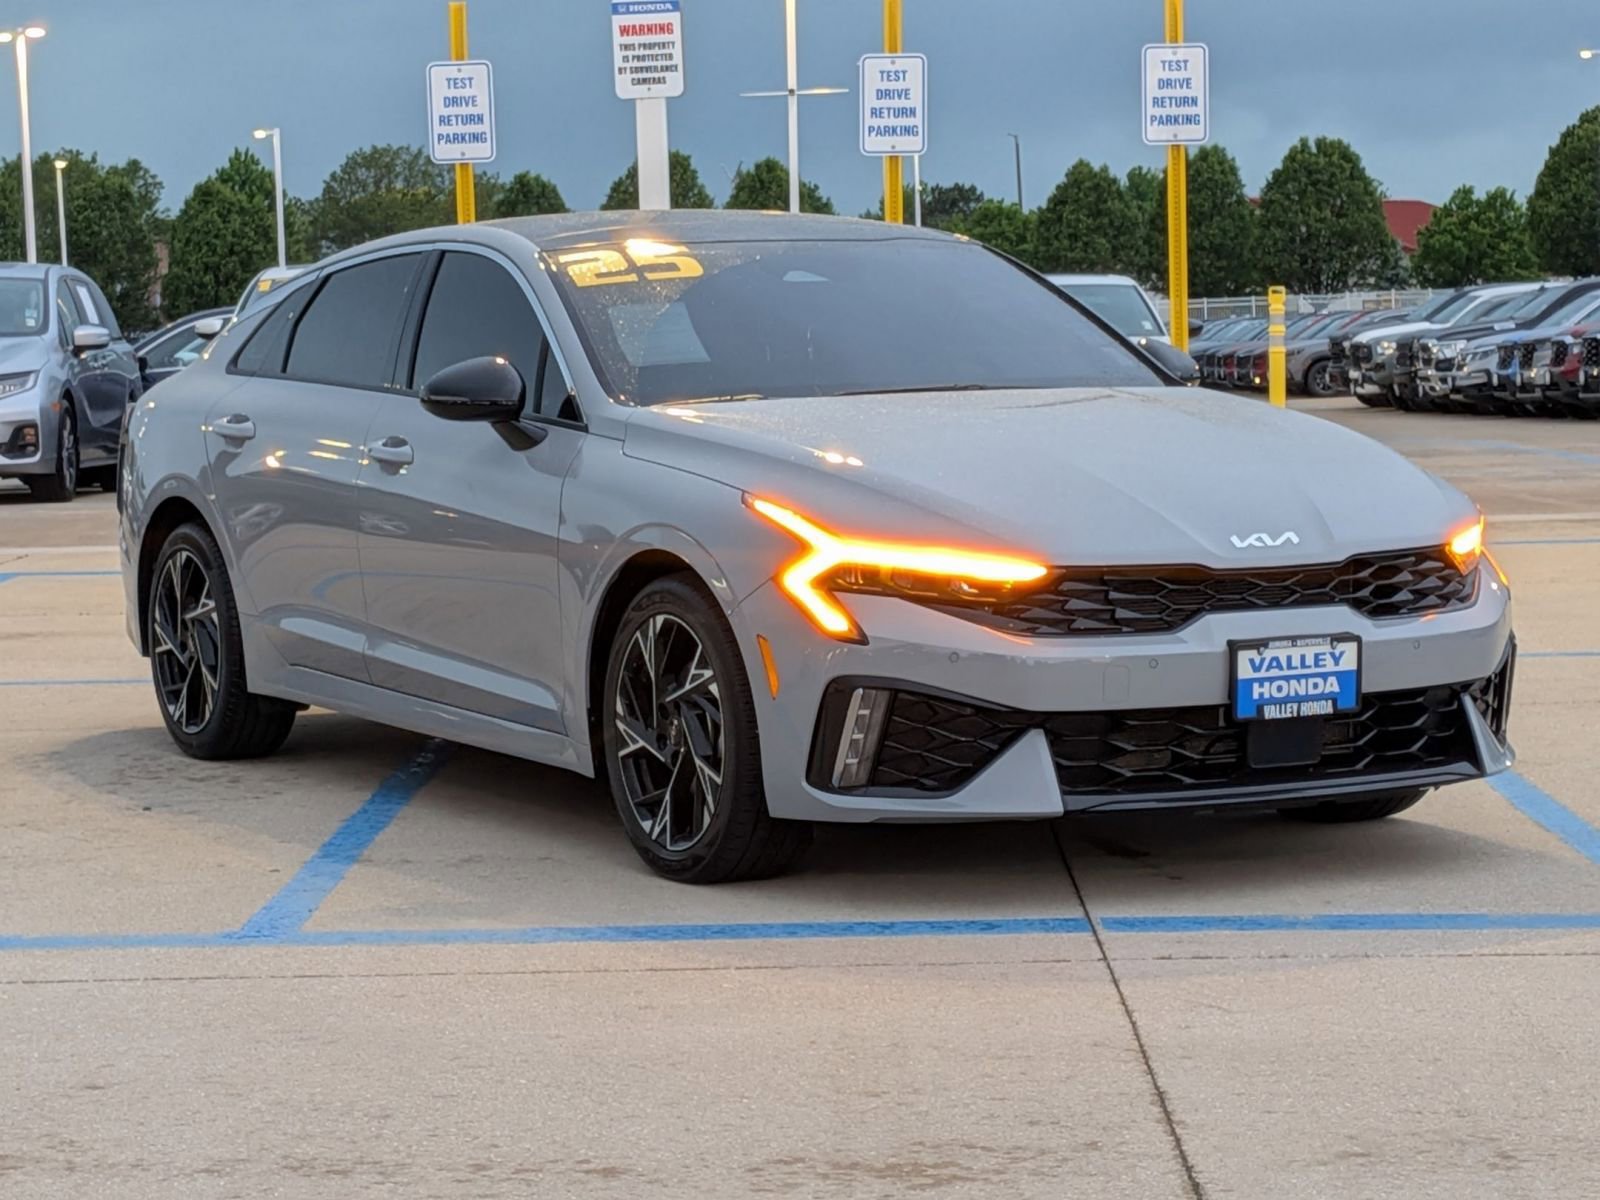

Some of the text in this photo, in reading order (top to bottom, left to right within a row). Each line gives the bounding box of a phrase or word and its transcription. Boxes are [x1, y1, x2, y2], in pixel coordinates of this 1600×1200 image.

[629, 3, 673, 12] HONDA
[619, 22, 674, 37] WARNING
[619, 41, 676, 52] THIS PROPERTY
[622, 53, 674, 63] IS PROTECTED
[618, 66, 628, 75] BY
[1160, 59, 1189, 72] TEST
[631, 76, 667, 86] CAMERAS
[879, 70, 908, 82] TEST
[446, 77, 474, 89] TEST
[1157, 77, 1192, 90] DRIVE
[875, 88, 911, 100] DRIVE
[443, 95, 478, 108] DRIVE
[1152, 96, 1198, 108] RETURN
[870, 106, 917, 119] RETURN
[438, 113, 484, 126] RETURN
[1150, 114, 1201, 127] PARKING
[868, 125, 919, 137] PARKING
[437, 132, 488, 145] PARKING
[558, 239, 704, 287] 25
[1248, 650, 1346, 673] VALLEY
[1252, 676, 1340, 700] HONDA
[1264, 699, 1334, 719] VALLEY HONDA
